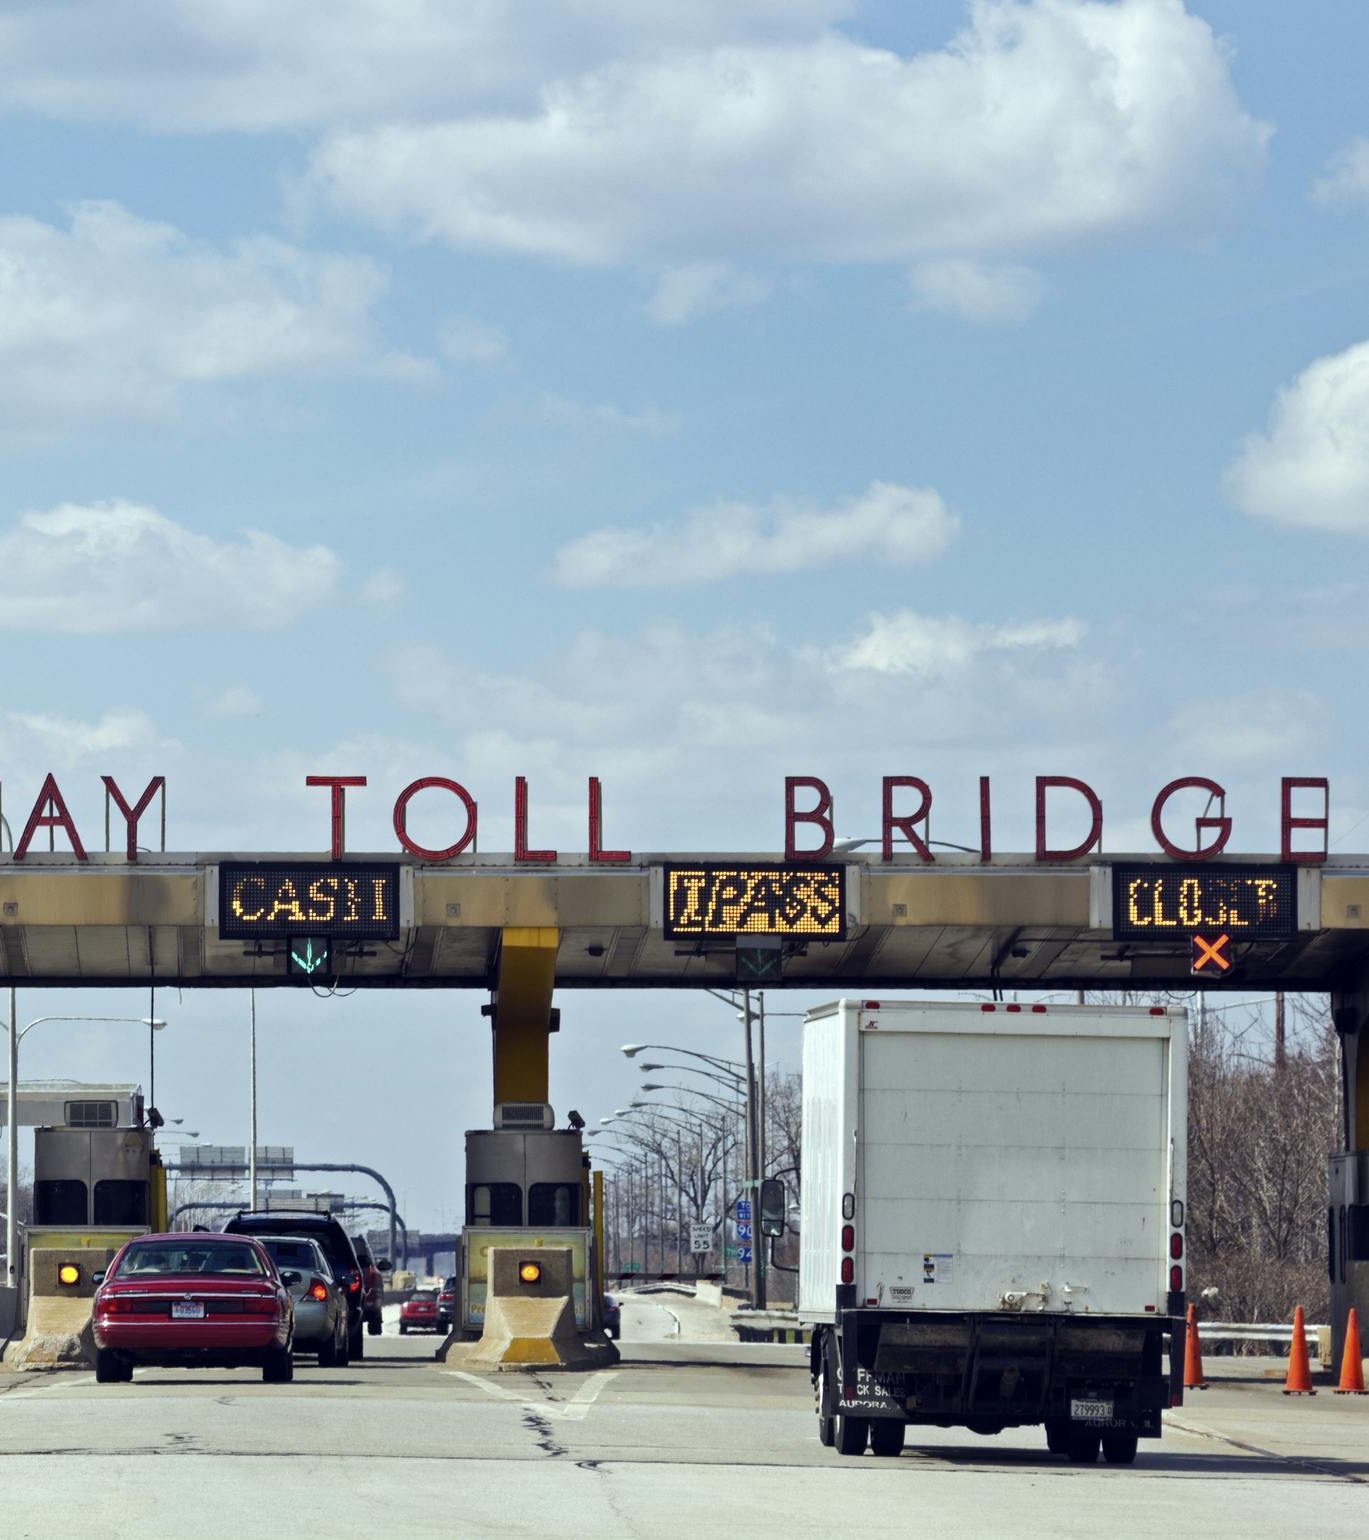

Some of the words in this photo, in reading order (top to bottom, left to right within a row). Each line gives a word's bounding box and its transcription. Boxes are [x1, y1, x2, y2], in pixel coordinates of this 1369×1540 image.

[306, 776, 631, 862] TOLL
[784, 776, 1328, 862] BRIDGE
[694, 1240, 710, 1250] 55
